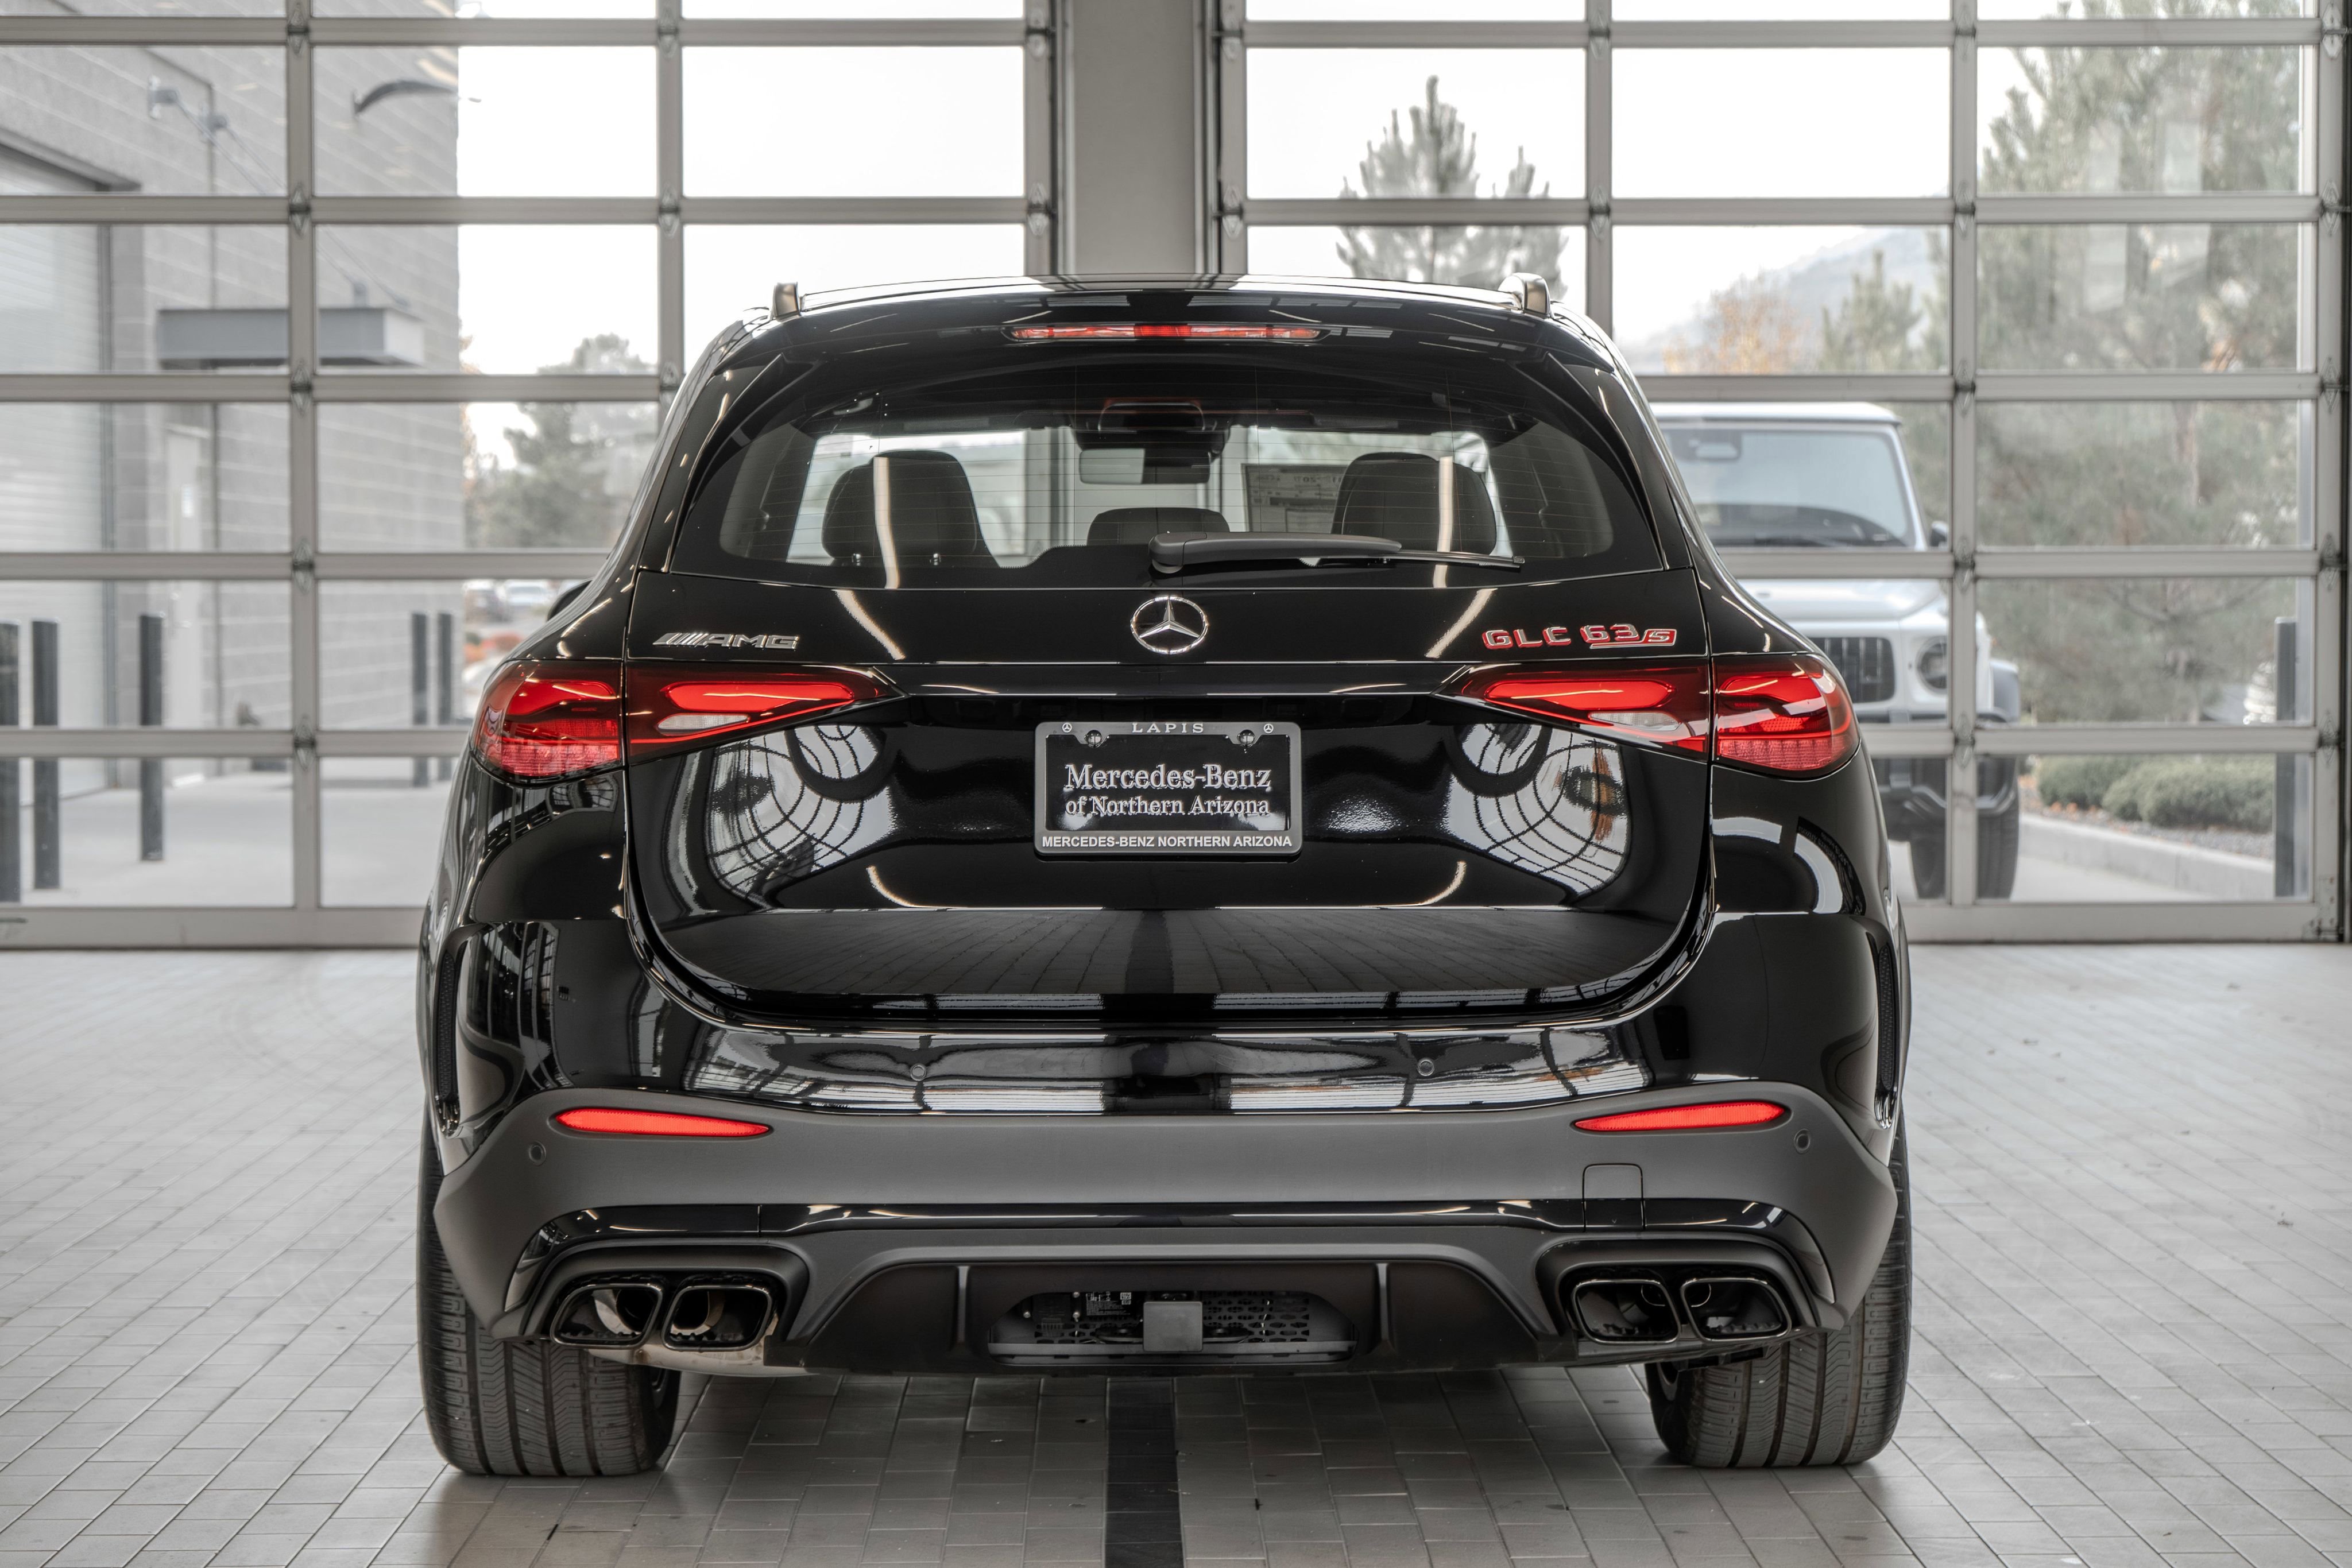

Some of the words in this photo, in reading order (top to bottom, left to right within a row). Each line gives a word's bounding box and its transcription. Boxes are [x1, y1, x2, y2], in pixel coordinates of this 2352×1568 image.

[703, 633, 799, 649] AMG
[1482, 627, 1572, 650] GLC
[1132, 723, 1204, 733] LAPIS
[1065, 764, 1272, 789] Mercedes-Benz
[1065, 796, 1087, 814] of
[1089, 796, 1184, 815] Northern
[1189, 795, 1271, 815] Arizona
[1042, 836, 1155, 847] MERCEDES-BENZ
[1158, 836, 1230, 847] NORTHERN
[1233, 836, 1292, 847] ARIZONA
